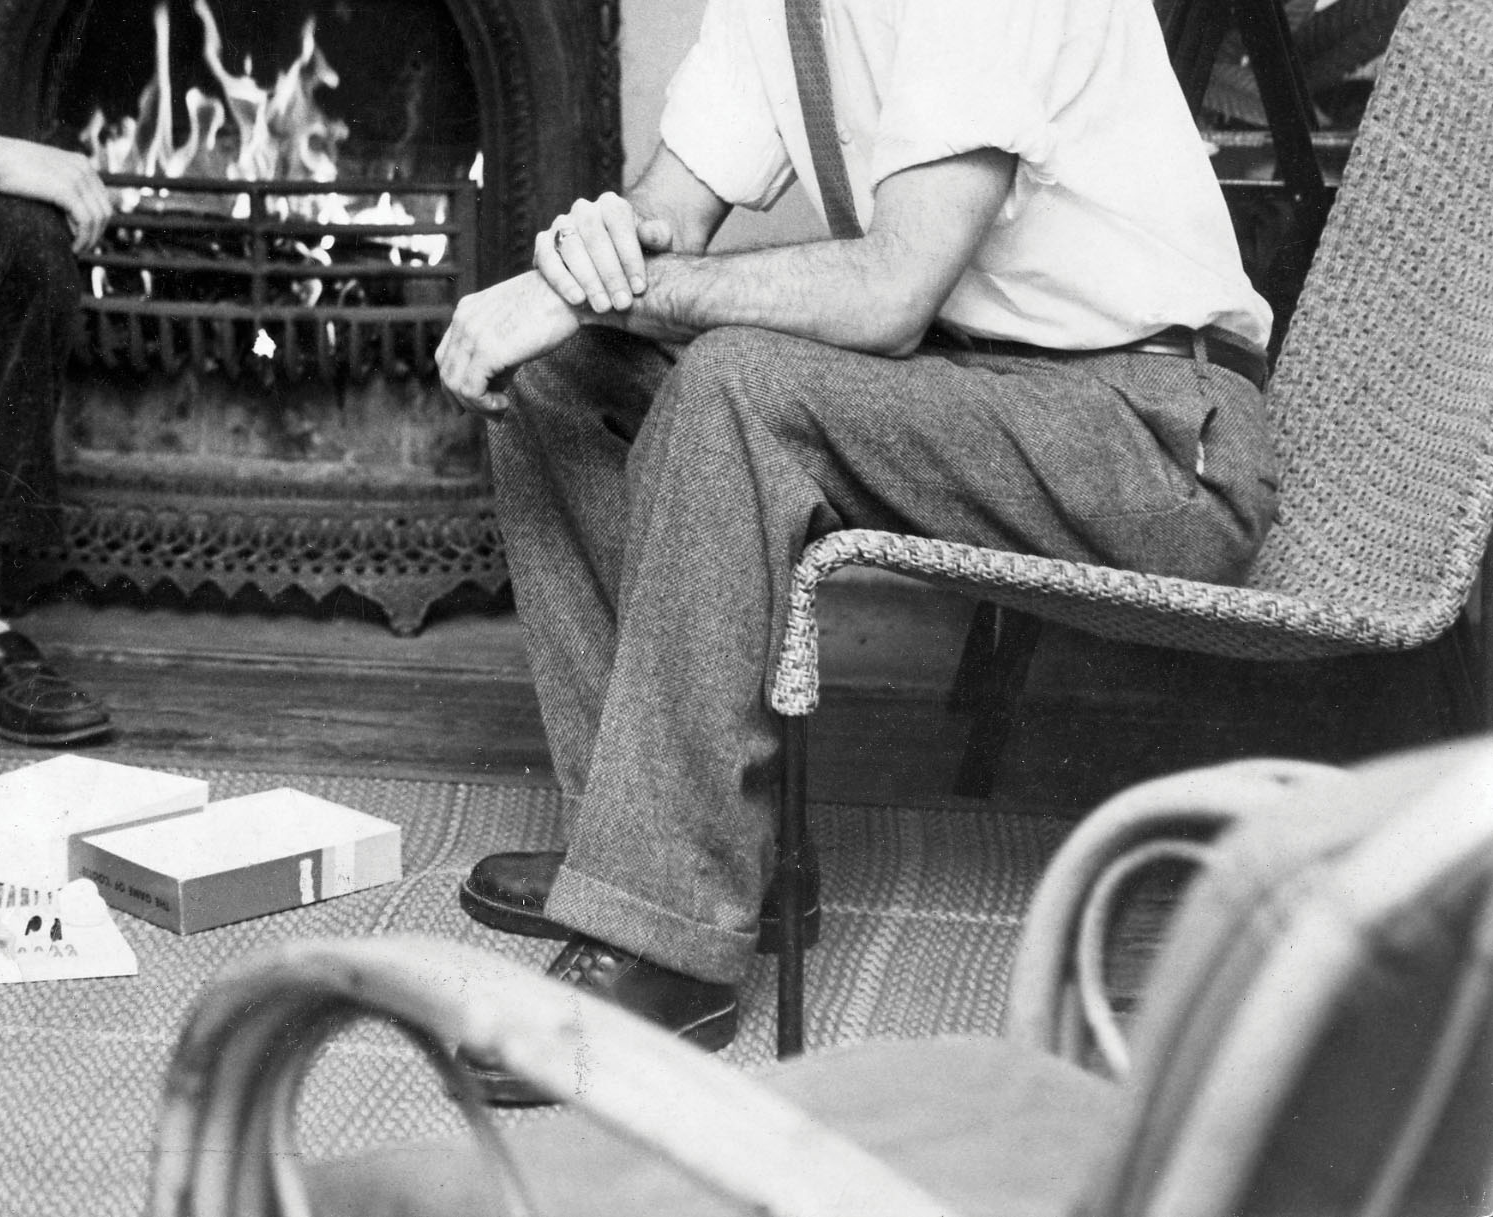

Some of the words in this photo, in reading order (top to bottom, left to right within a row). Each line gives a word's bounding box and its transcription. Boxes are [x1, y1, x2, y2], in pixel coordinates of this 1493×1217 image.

[114, 880, 126, 893] OF
[129, 885, 152, 904] GAME
[155, 896, 170, 912] THE
